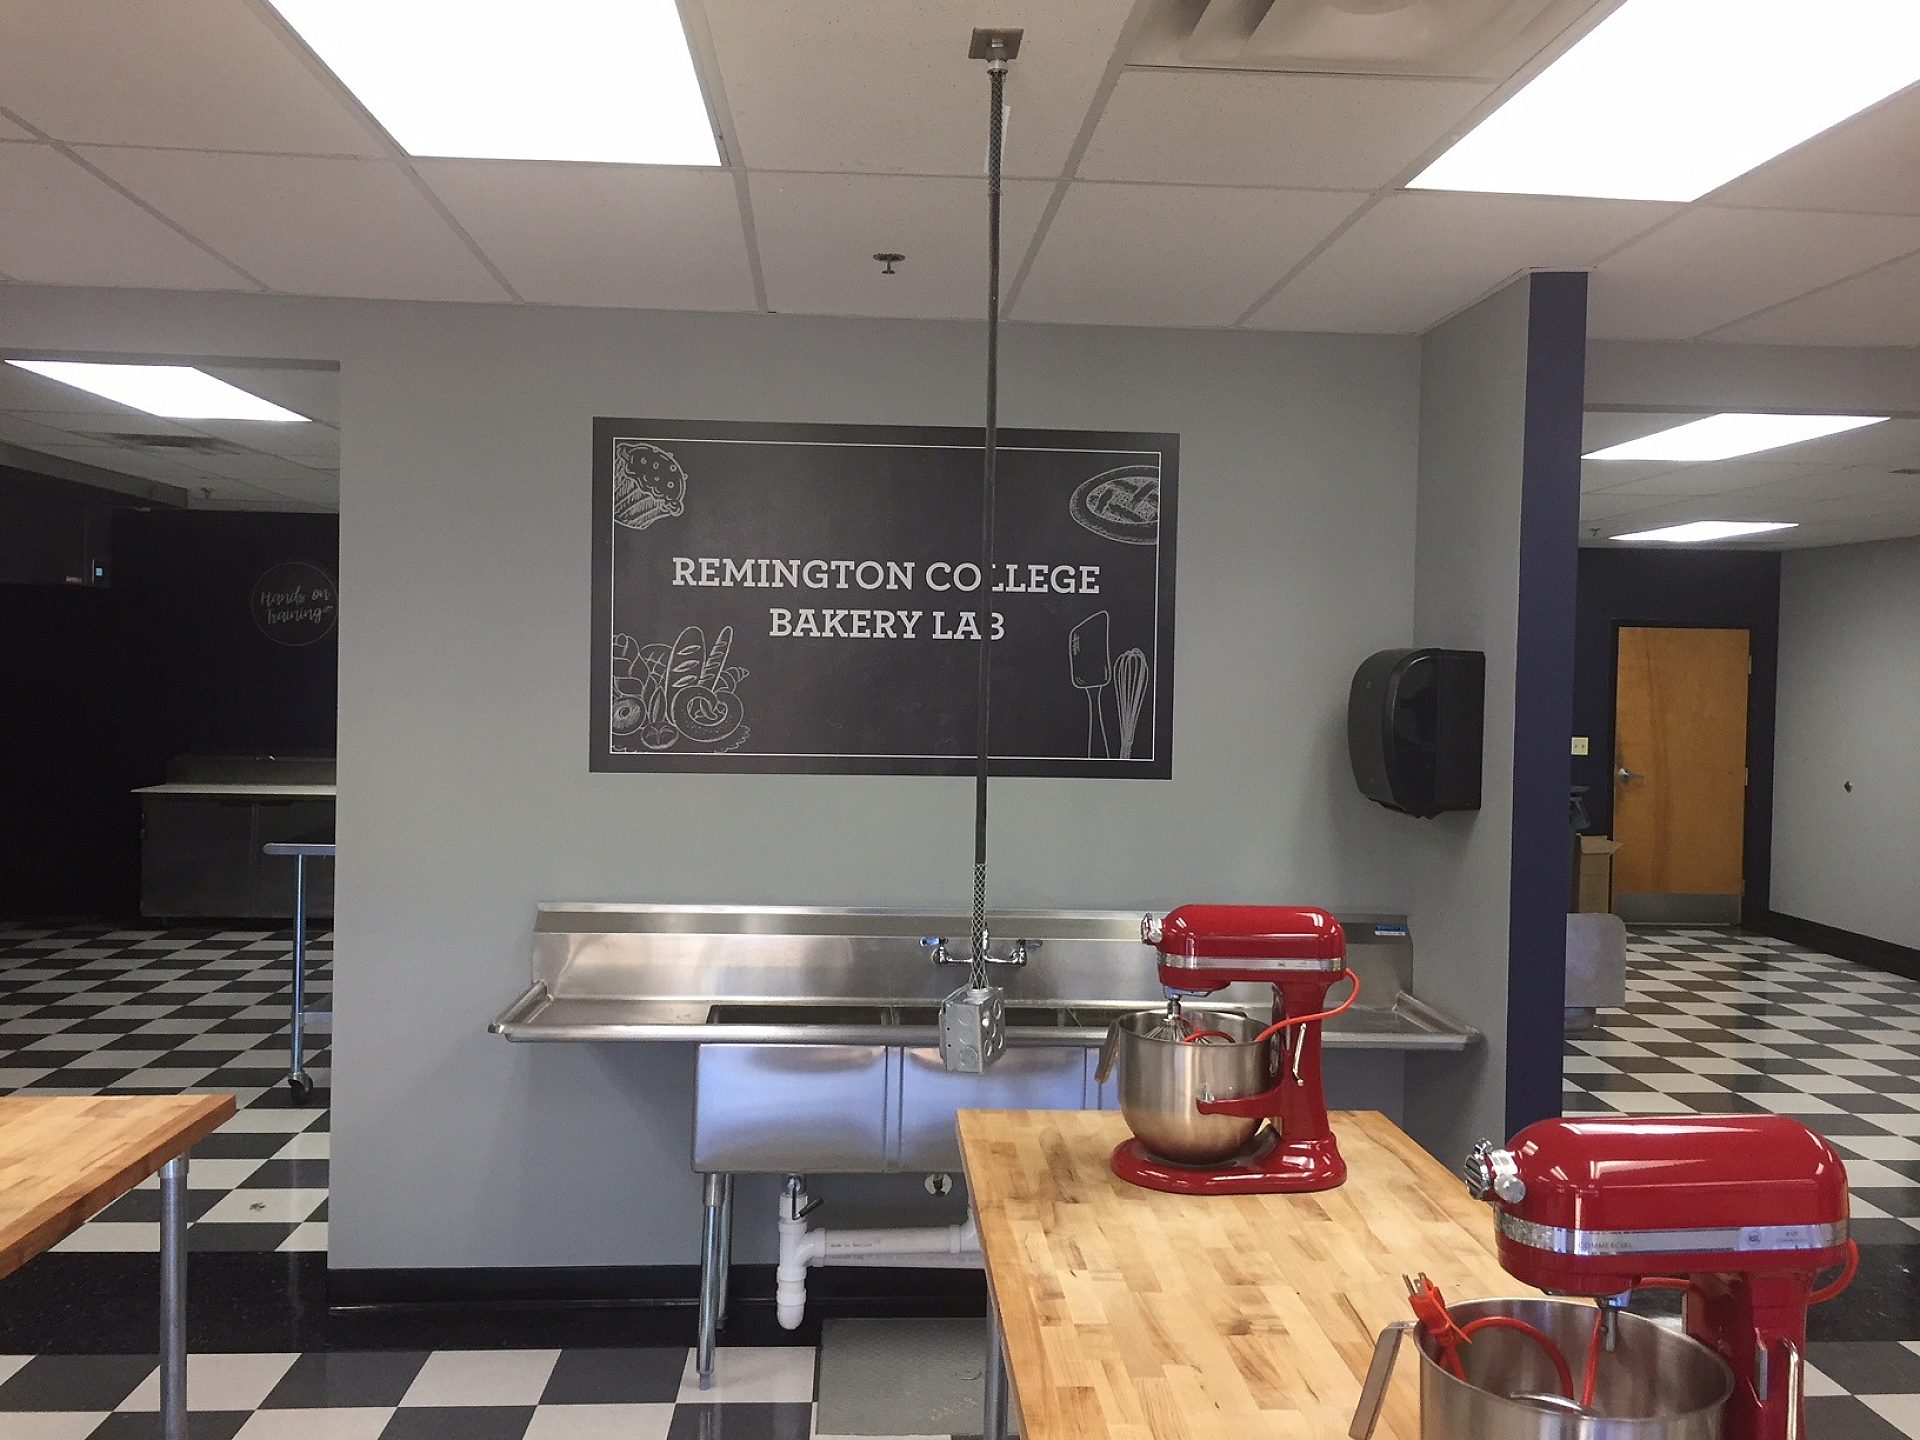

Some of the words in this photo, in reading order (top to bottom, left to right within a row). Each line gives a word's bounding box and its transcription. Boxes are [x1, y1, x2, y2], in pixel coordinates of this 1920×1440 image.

[672, 557, 915, 590] REMINGTON
[260, 584, 306, 607] Hands
[311, 588, 331, 601] on
[266, 606, 333, 624] Training
[769, 607, 923, 639] BAKERY
